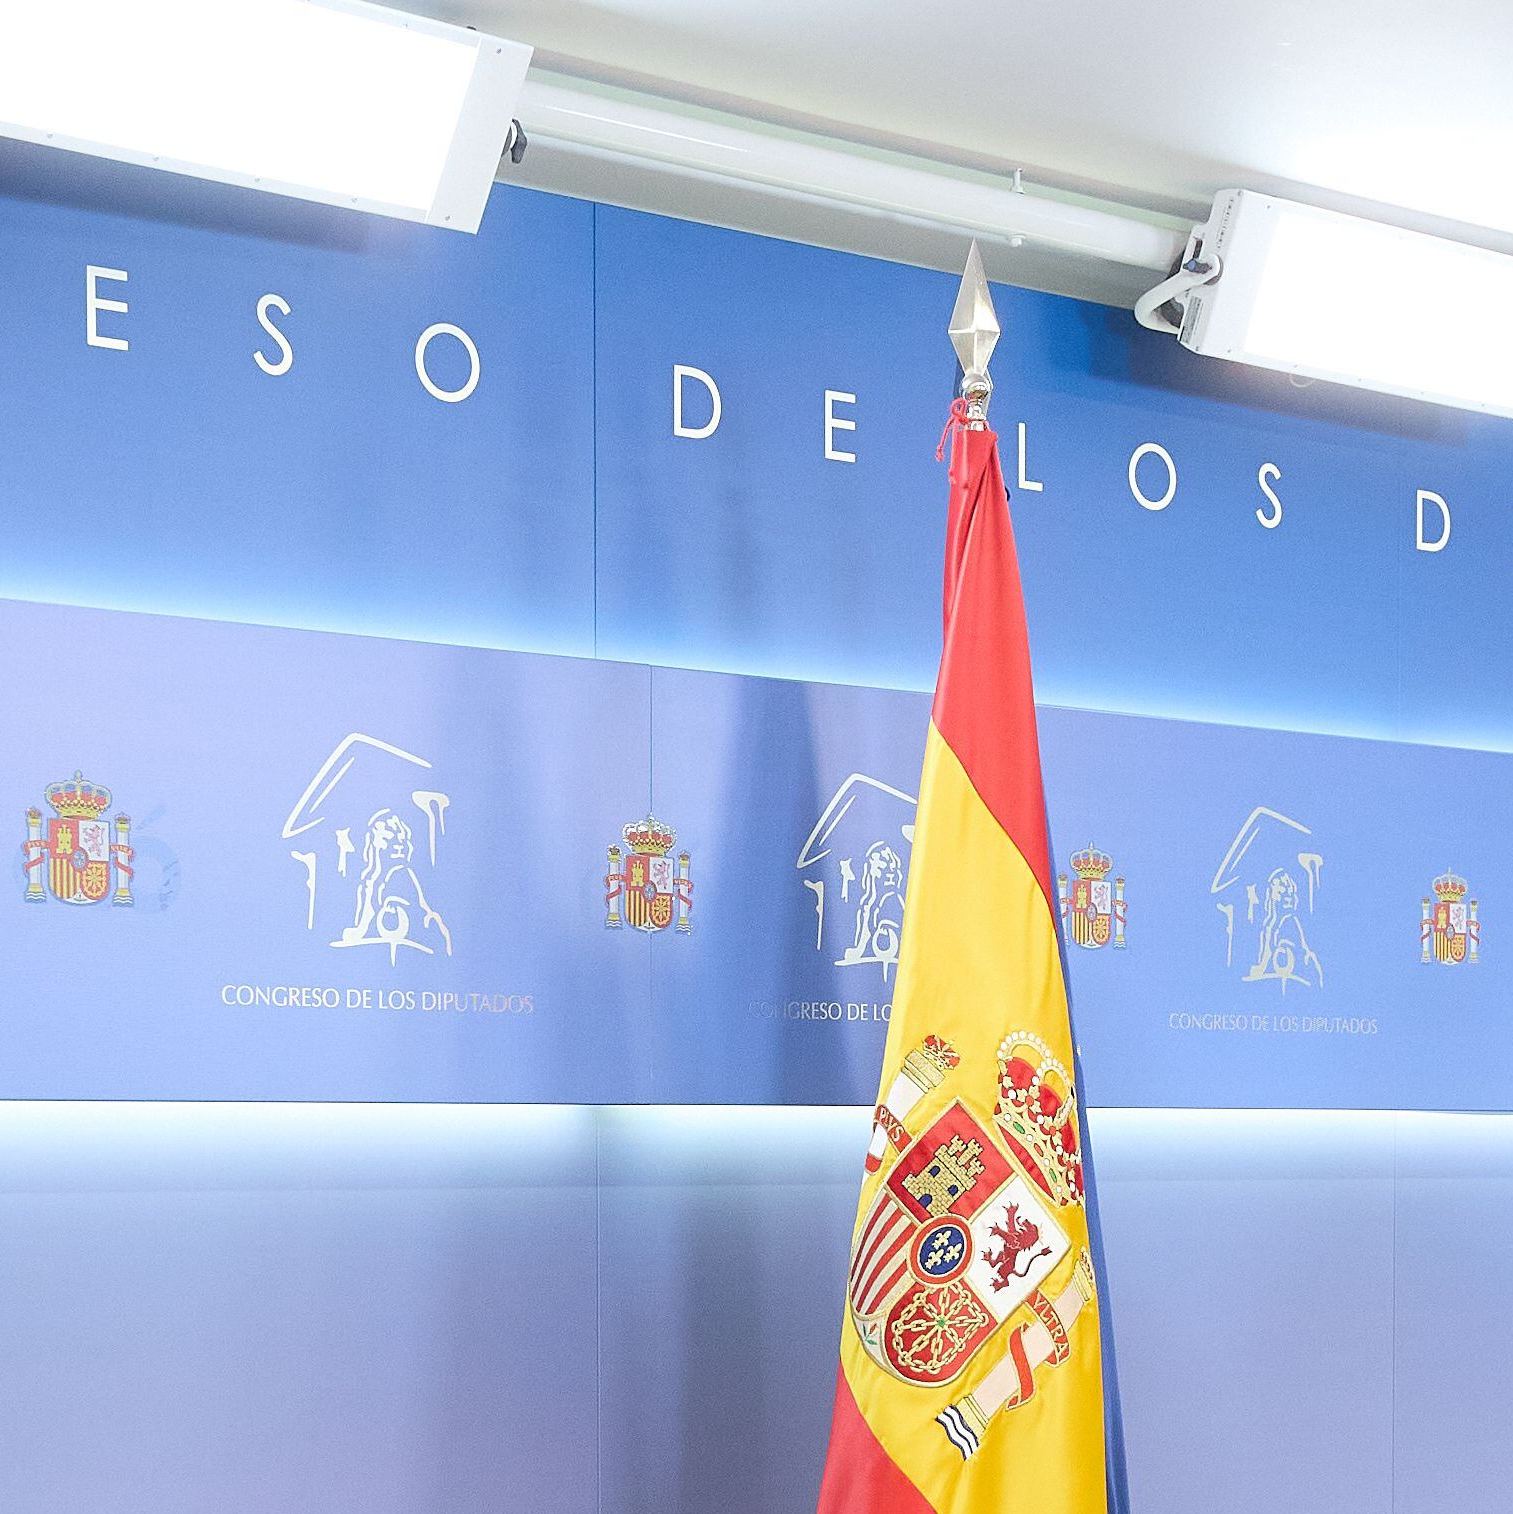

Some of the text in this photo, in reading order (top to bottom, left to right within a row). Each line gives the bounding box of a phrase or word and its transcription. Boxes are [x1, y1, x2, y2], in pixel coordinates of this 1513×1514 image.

[673, 364, 856, 463] DE
[1018, 422, 1283, 529] LOS
[220, 985, 535, 1014] CONGRESO DE LOS DIPUTADOS
[847, 1003, 869, 1021] DE
[874, 1003, 893, 1022] LO
[1169, 1012, 1378, 1034] CONGRESO DE LOS DIPUTADOS
[1033, 1292, 1069, 1365] VLTRA
